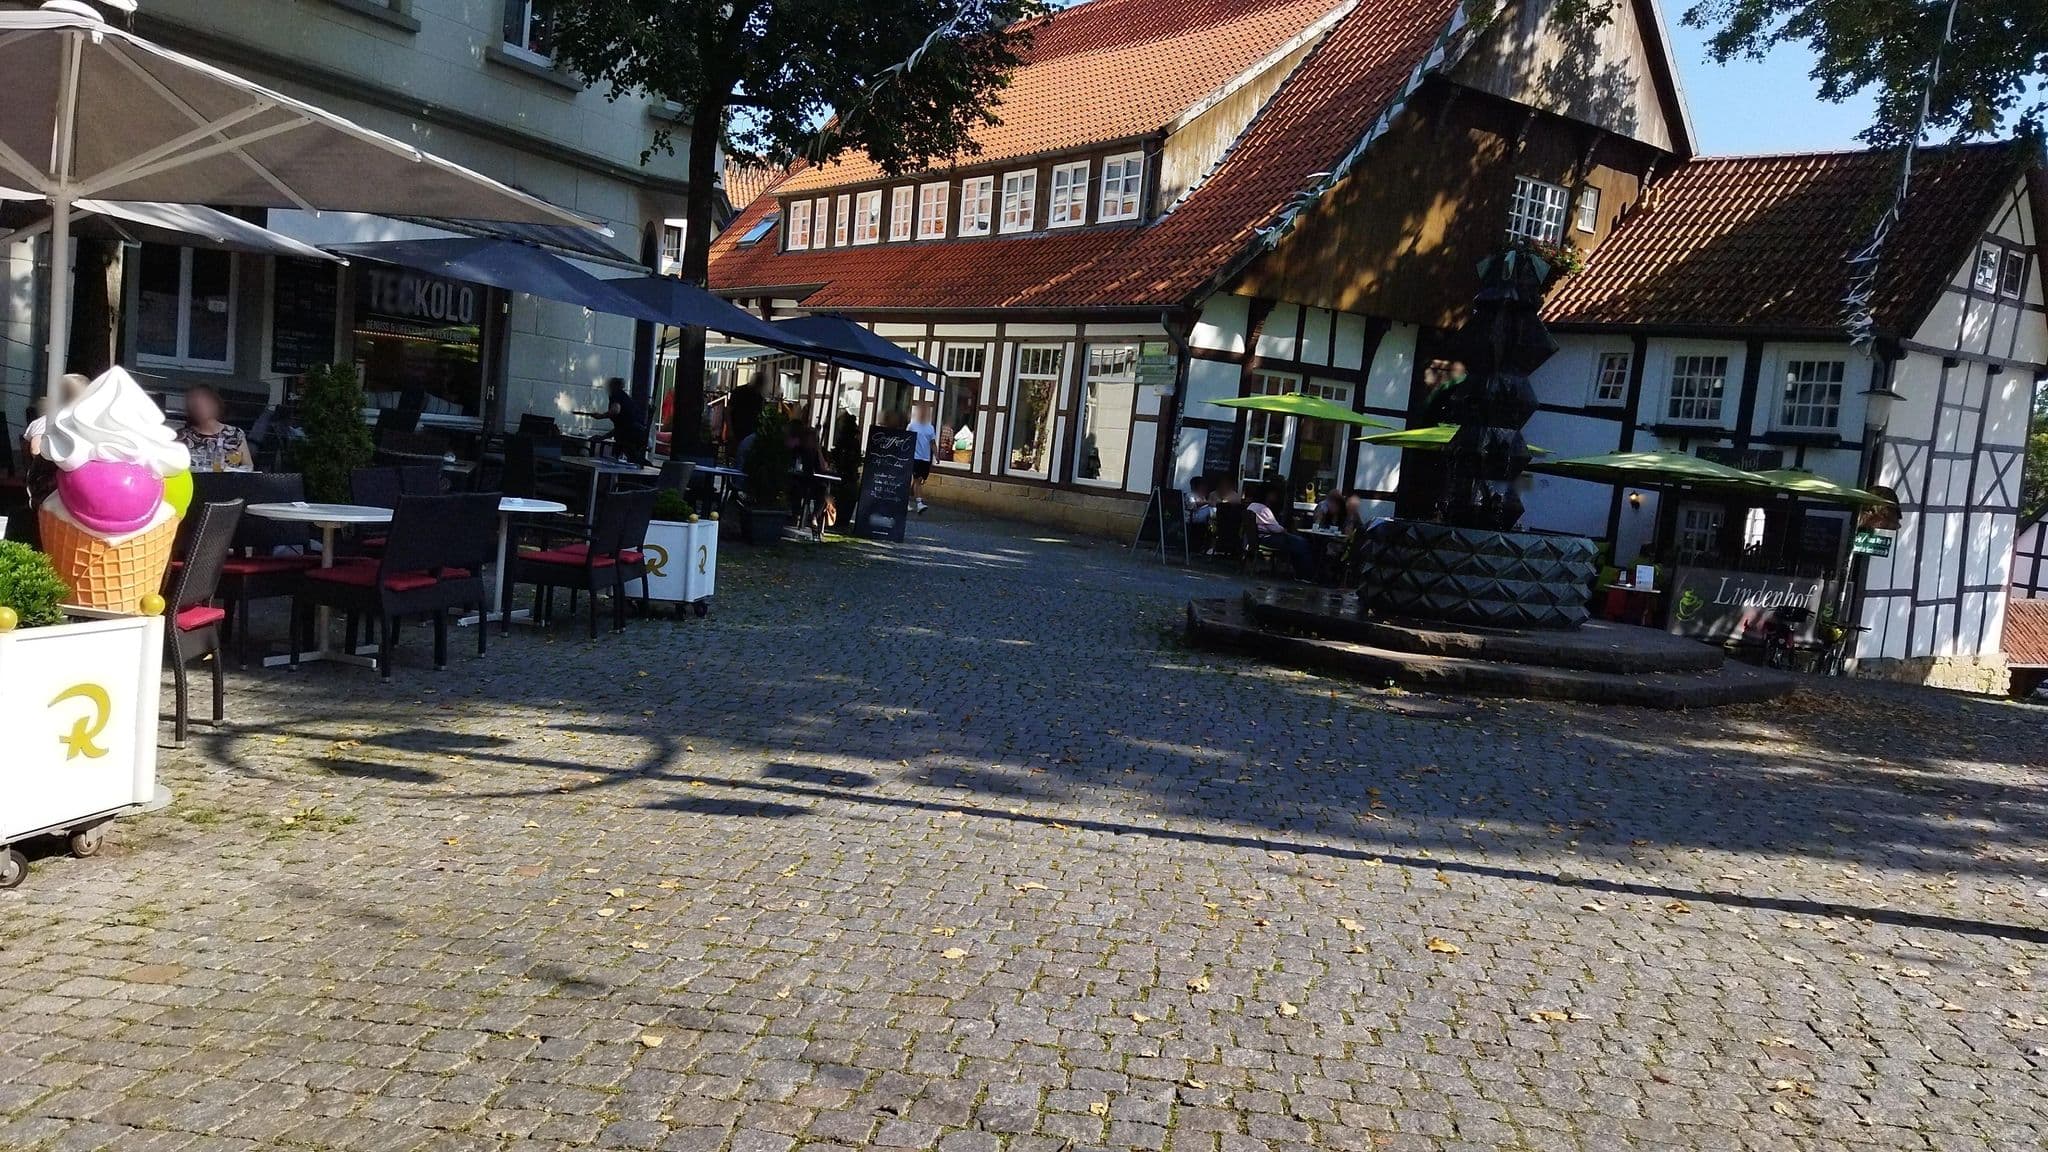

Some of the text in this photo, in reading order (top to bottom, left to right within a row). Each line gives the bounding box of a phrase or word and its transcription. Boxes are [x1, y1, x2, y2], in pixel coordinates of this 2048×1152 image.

[368, 268, 473, 324] TECKOLO
[1713, 576, 1817, 609] Lindenhof
[47, 683, 111, 761] R
